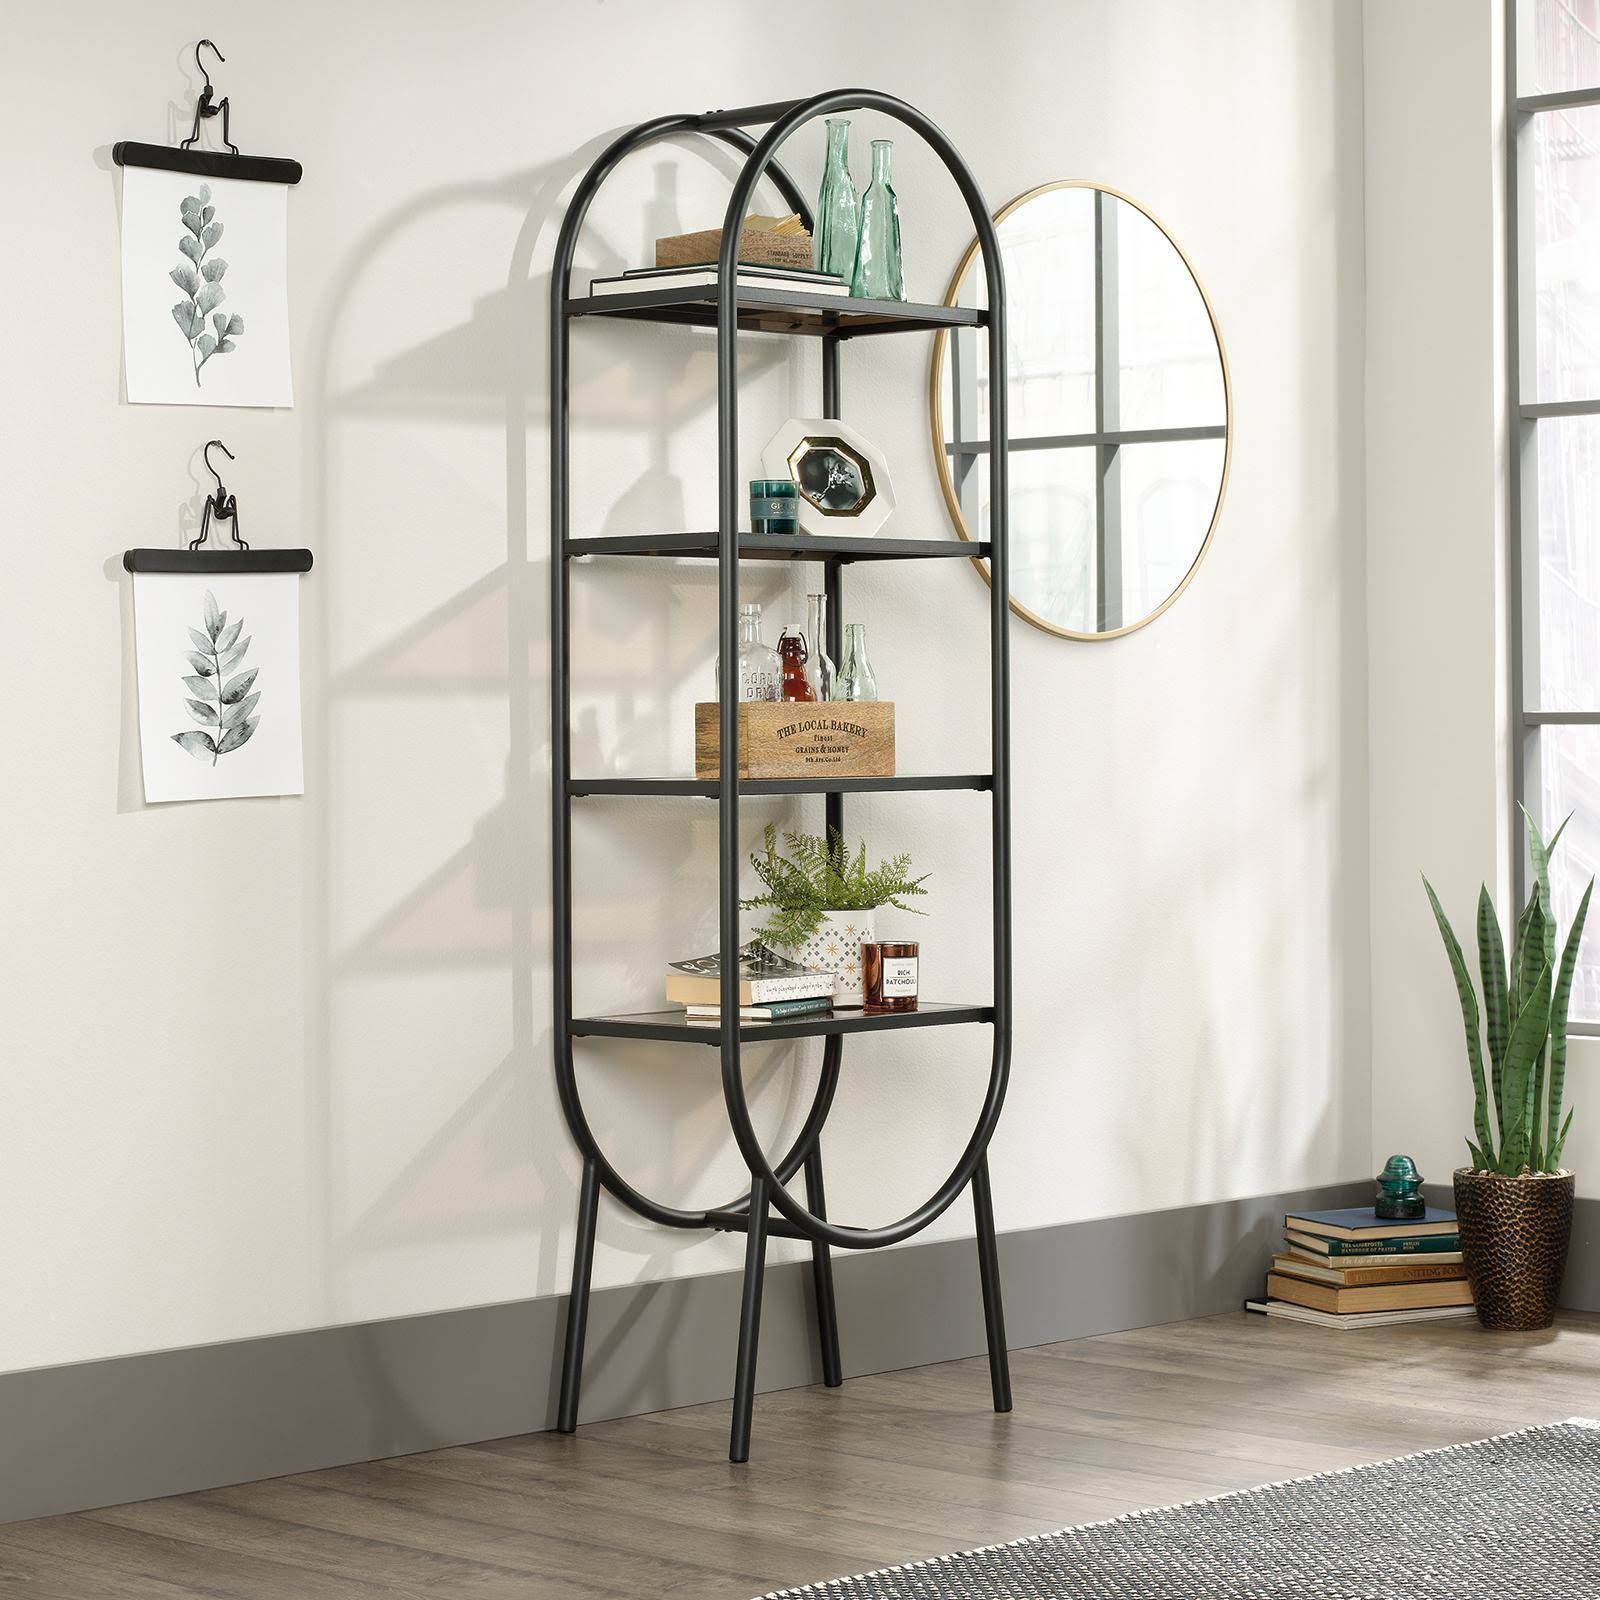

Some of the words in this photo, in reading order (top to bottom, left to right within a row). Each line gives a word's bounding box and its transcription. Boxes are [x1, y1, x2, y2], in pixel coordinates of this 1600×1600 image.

[777, 724, 797, 739] THE
[799, 720, 829, 733] LOCAL
[831, 720, 868, 738] BAKERY
